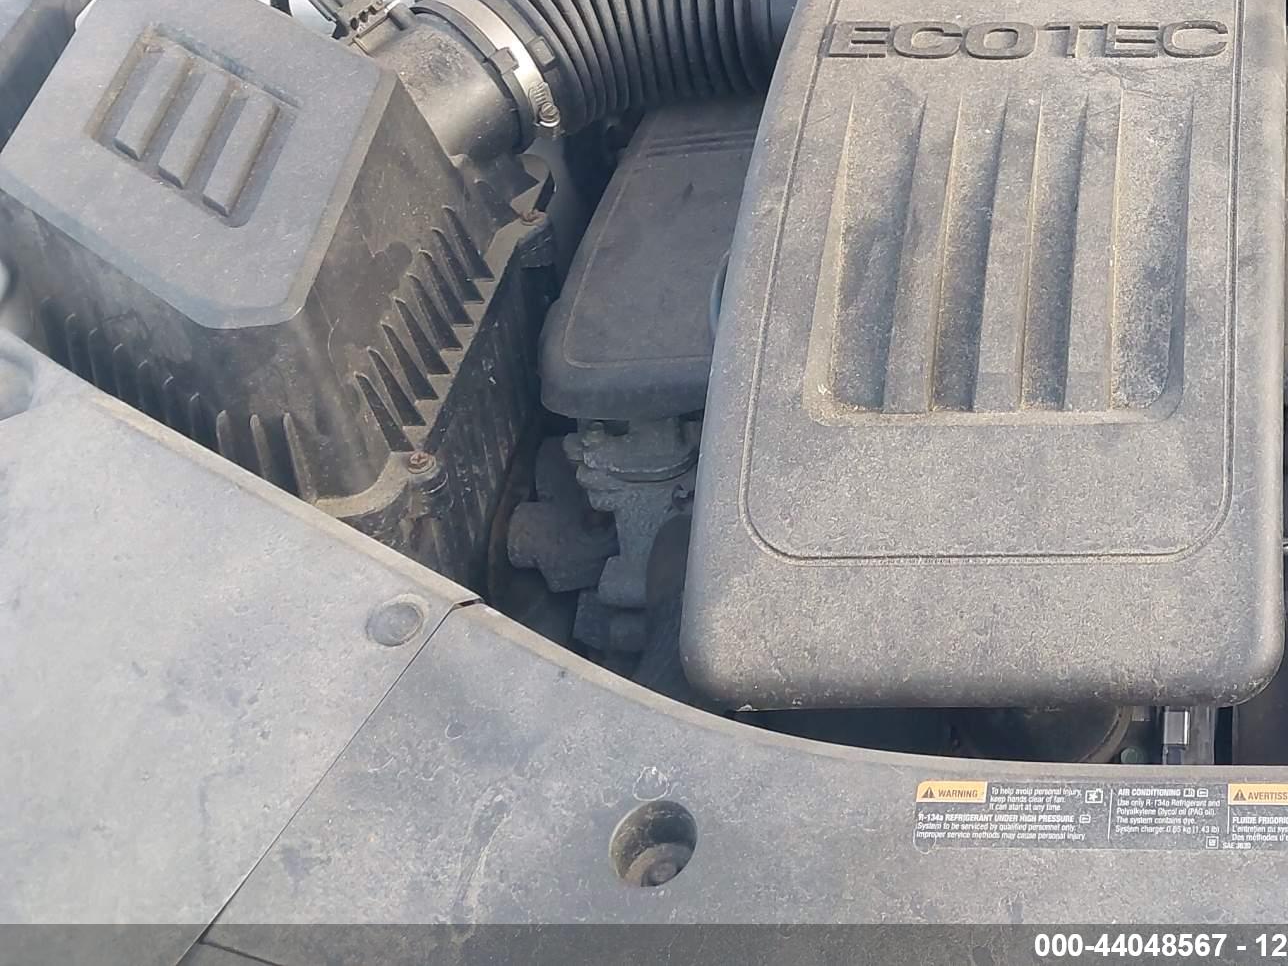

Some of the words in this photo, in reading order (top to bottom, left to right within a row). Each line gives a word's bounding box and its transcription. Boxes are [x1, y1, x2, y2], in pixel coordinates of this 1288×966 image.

[826, 20, 1231, 61] ECOTEC
[938, 789, 978, 798] WARNING
[1000, 787, 1014, 795] help
[1034, 788, 1061, 796] personal
[1131, 799, 1144, 807] only
[1171, 800, 1206, 808] Refrigerant
[1117, 808, 1156, 816] Polyalkylene
[1158, 808, 1176, 816] Glycol
[1188, 808, 1203, 816] (PAG
[945, 814, 992, 822] REFRIGERANT
[990, 823, 997, 831] by
[1183, 826, 1191, 834] kg
[917, 831, 946, 839] Improper
[1038, 833, 1066, 841] personal
[1246, 833, 1277, 841] méthodes
